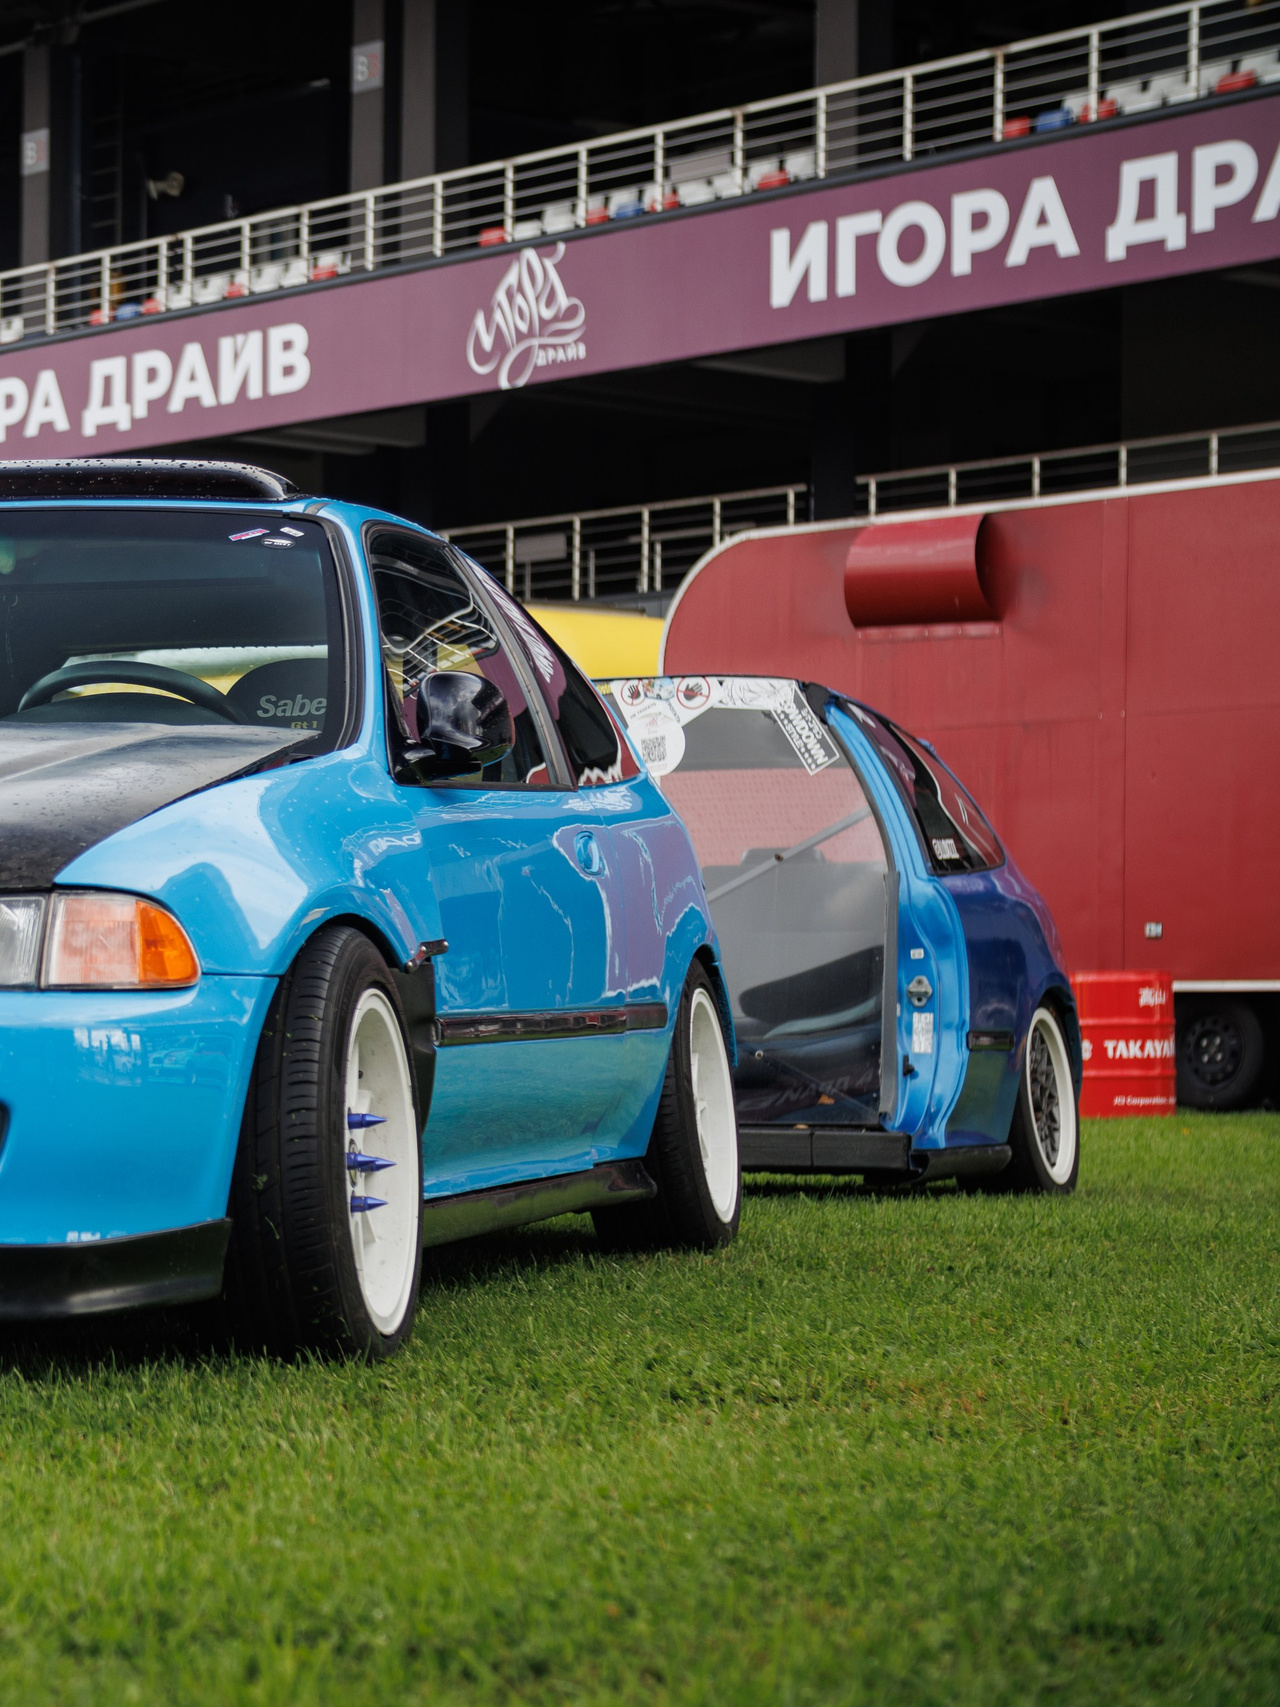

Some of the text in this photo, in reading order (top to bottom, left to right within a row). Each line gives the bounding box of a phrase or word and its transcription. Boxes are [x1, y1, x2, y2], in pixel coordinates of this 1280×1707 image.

[769, 175, 1081, 309] ИГОРА
[82, 322, 312, 437] ДРАЙВ
[257, 694, 327, 717] Sabe
